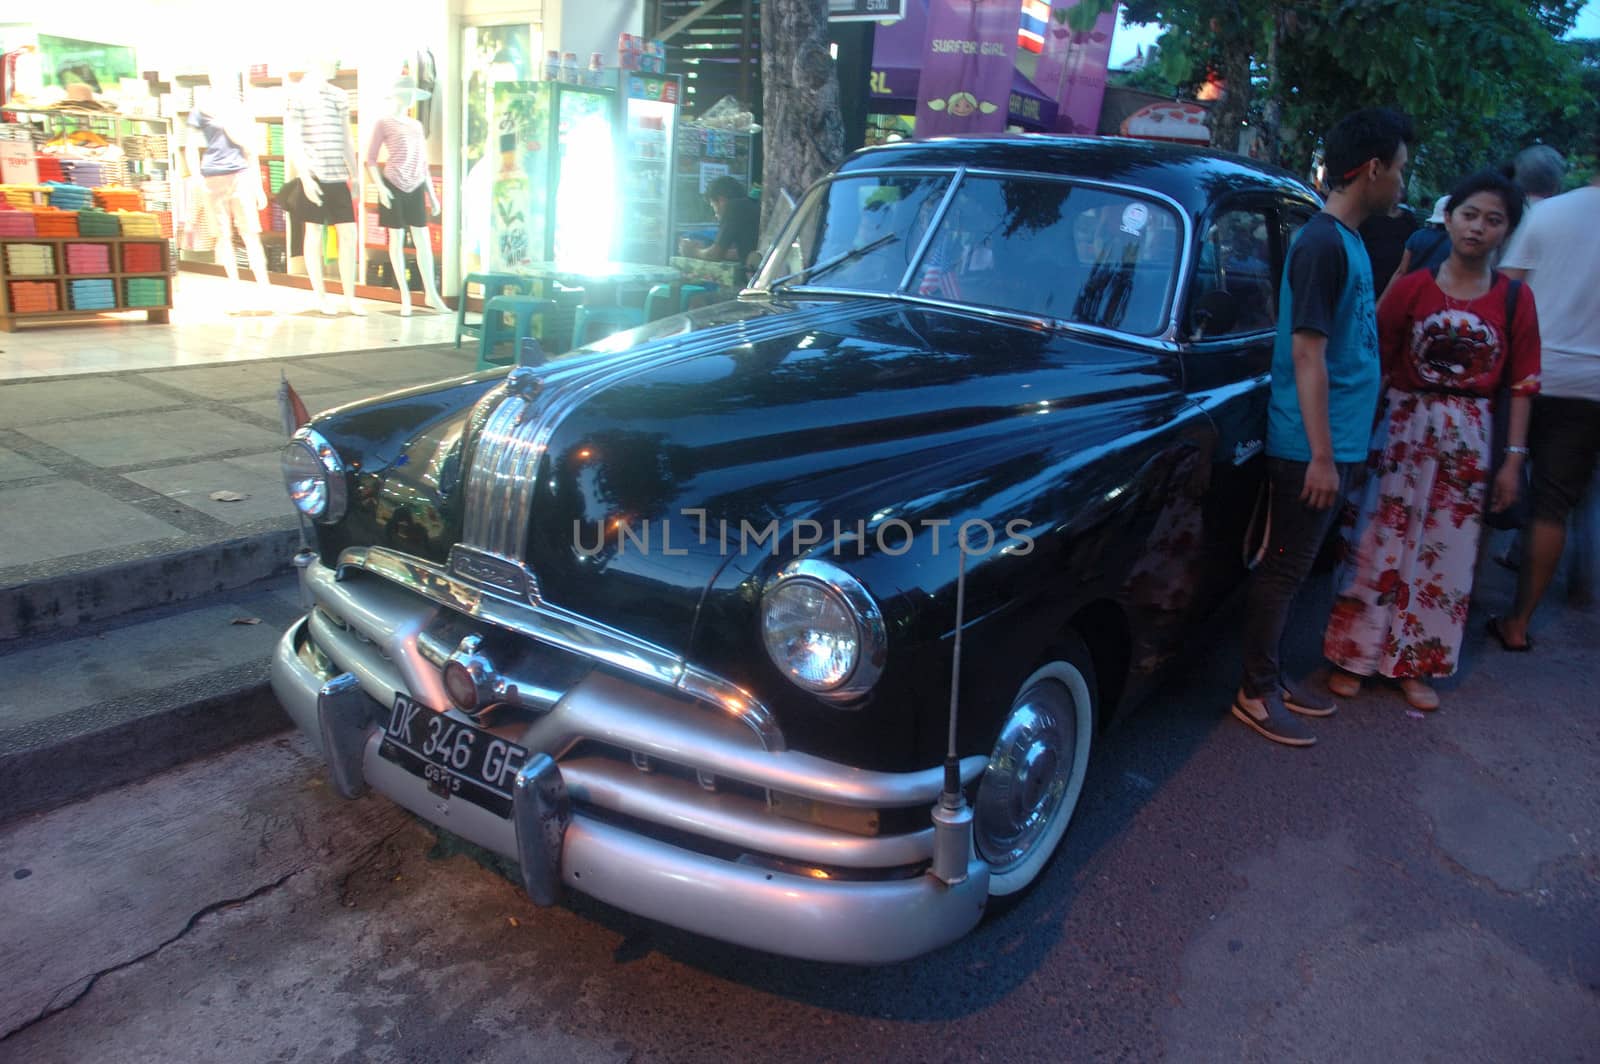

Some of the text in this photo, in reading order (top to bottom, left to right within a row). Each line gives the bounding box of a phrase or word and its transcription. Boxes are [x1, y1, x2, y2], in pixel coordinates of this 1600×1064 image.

[981, 42, 1008, 57] GIRL
[388, 697, 526, 787] DK 346 GF
